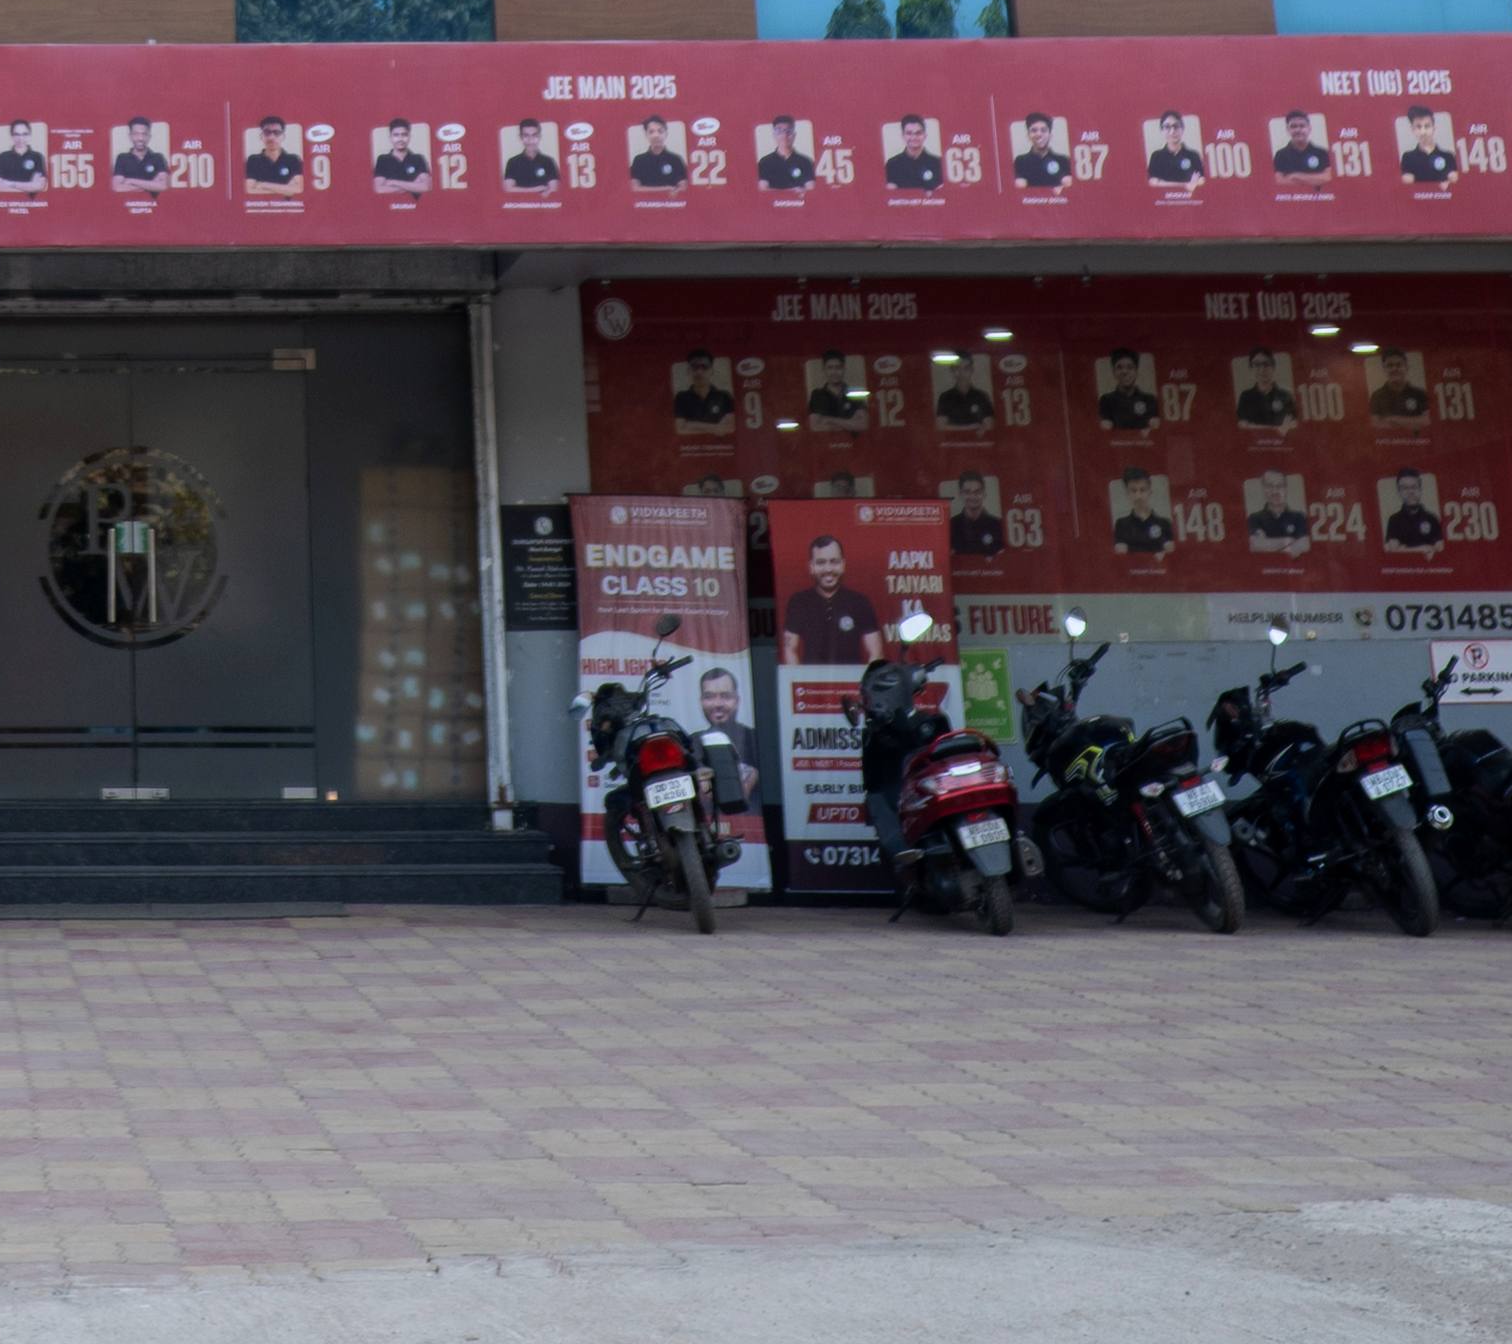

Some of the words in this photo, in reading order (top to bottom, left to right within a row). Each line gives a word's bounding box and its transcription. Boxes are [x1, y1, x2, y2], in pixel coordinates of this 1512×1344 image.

[542, 75, 574, 101] JEE
[578, 74, 626, 100] MAIN
[630, 74, 677, 101] 2025
[1320, 70, 1361, 97] NEET
[1367, 69, 1403, 98] (UG)
[1407, 69, 1452, 96] 2025
[697, 136, 718, 148] AIR
[822, 135, 843, 147] AIR
[952, 134, 972, 146] AIR
[1080, 131, 1101, 143] AIR
[1216, 128, 1236, 141] AIR
[1339, 127, 1358, 140] AIR
[1468, 123, 1489, 136] AIR
[63, 139, 83, 151] AIR
[183, 139, 203, 150] AIR
[312, 143, 331, 154] AIR
[443, 143, 462, 154] AIR
[570, 141, 591, 153] AIR
[1330, 140, 1373, 178] 131
[1456, 136, 1508, 174] 148
[50, 153, 95, 190] 155
[171, 153, 215, 189] 210
[313, 156, 332, 191] 9
[438, 154, 468, 190] 12
[567, 153, 597, 190] 13
[690, 149, 728, 187] 22
[815, 148, 855, 186] 45
[945, 147, 982, 184] 63
[1075, 144, 1110, 181] 87
[1205, 142, 1252, 179] 100
[771, 295, 804, 321] JEE
[810, 294, 863, 321] MAIN
[867, 293, 918, 320] 2025
[1204, 292, 1250, 321] NEET
[1257, 292, 1297, 323] (UG)
[1301, 292, 1353, 320] 2025
[744, 392, 764, 430] 9
[875, 389, 906, 428] 12
[1000, 389, 1033, 428] 13
[1161, 382, 1198, 422] 87
[1296, 382, 1346, 422] 100
[1433, 382, 1476, 422] 131
[629, 507, 708, 521] VIDYAPEETH
[875, 505, 941, 518] VIDYAPEETH
[1174, 502, 1226, 542] 148
[1309, 502, 1367, 542] 224
[1442, 501, 1500, 541] 230
[1006, 508, 1044, 548] 63
[584, 543, 736, 572] ENDGAME
[887, 550, 935, 571] AAPKI
[600, 575, 689, 597] CLASS
[692, 576, 721, 598] 10
[886, 574, 944, 595] TAIYARI
[901, 598, 927, 616] KA
[968, 603, 1060, 636] FUTURE.
[1289, 611, 1345, 625] NUMBER
[804, 783, 846, 795] EARLY
[816, 806, 860, 821] UPTO
